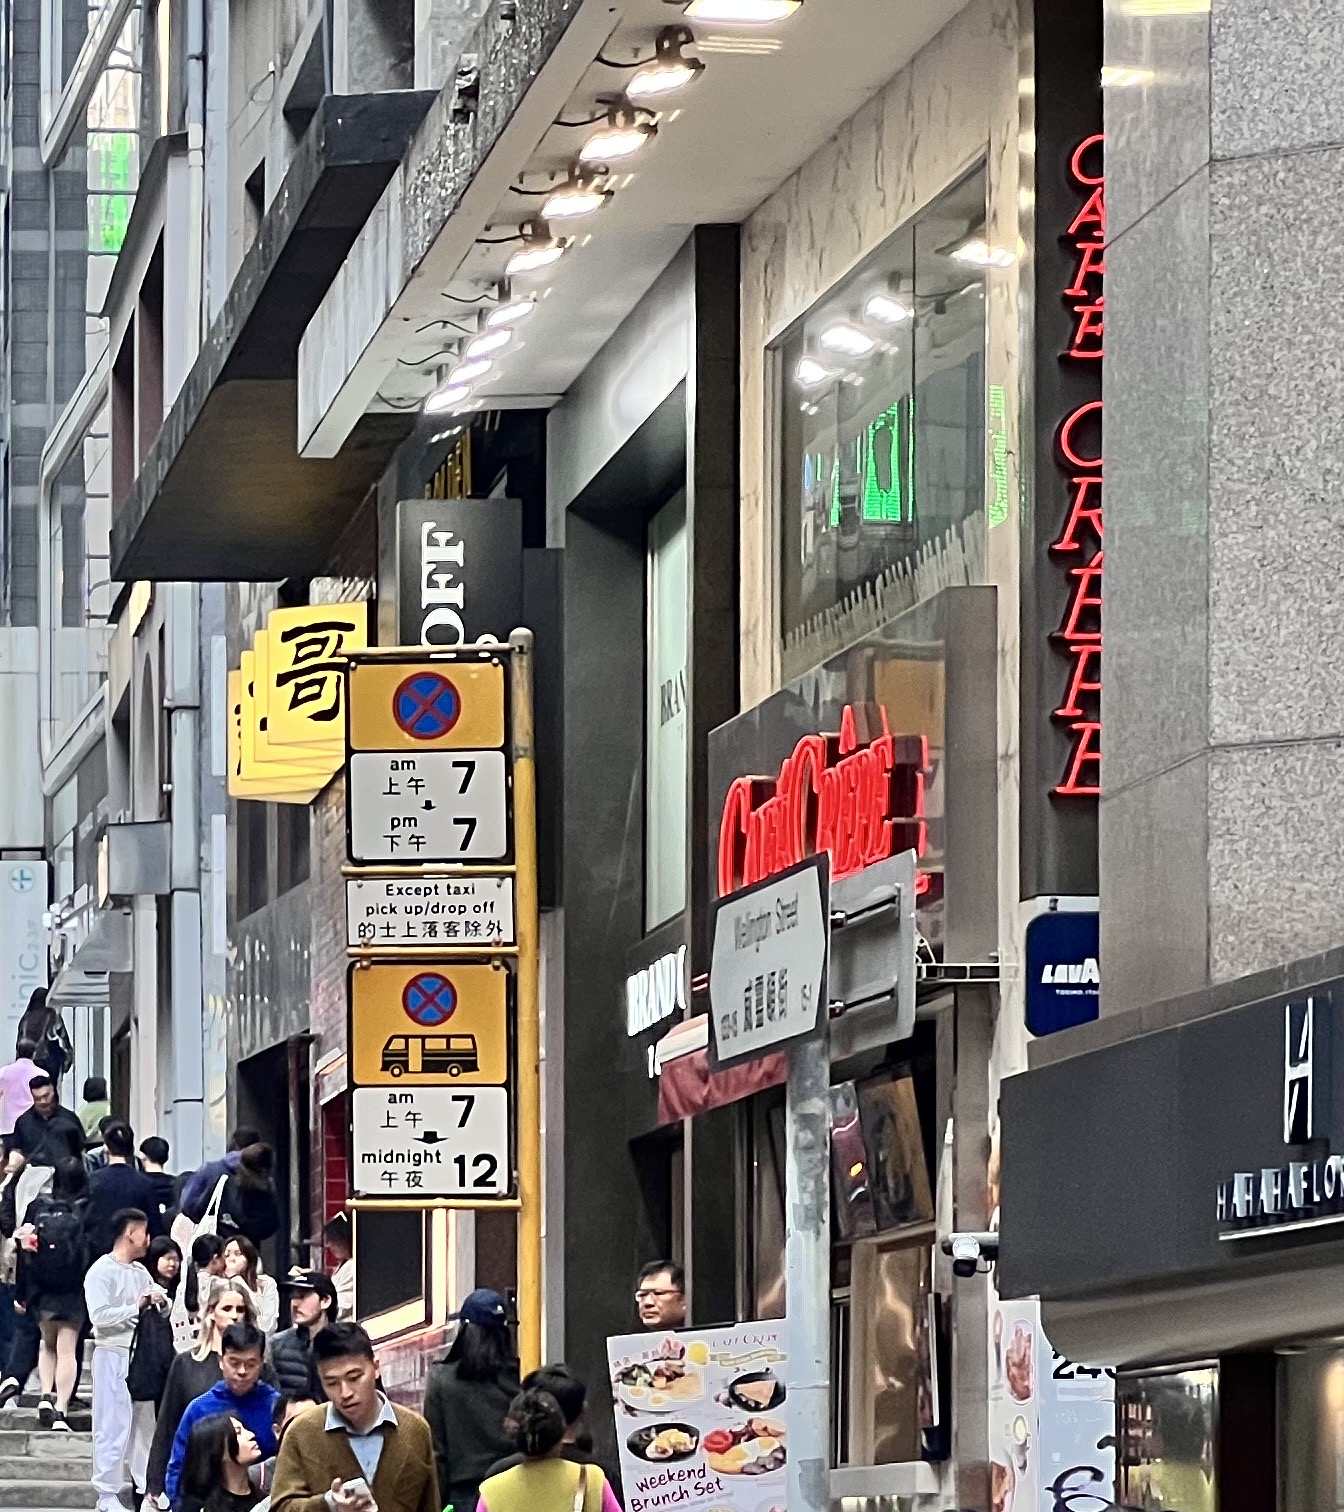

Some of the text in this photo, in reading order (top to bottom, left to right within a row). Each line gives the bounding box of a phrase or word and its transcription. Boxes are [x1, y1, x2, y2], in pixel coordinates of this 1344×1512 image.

[276, 621, 356, 722] 哥
[382, 777, 425, 795] 上午
[390, 760, 476, 794] am 7
[383, 834, 426, 852] 下午
[391, 817, 477, 851] pm 7
[386, 883, 475, 898] Except taxi
[366, 901, 495, 917] pick up/drop off
[358, 920, 503, 938] 的士上落客除外
[1041, 958, 1100, 984] LAVA
[380, 1110, 423, 1129] 上午
[388, 1093, 475, 1128] am 7
[362, 1149, 498, 1187] midnight 12
[381, 1170, 424, 1188] 午夜
[630, 1477, 724, 1512] Brunch Set
